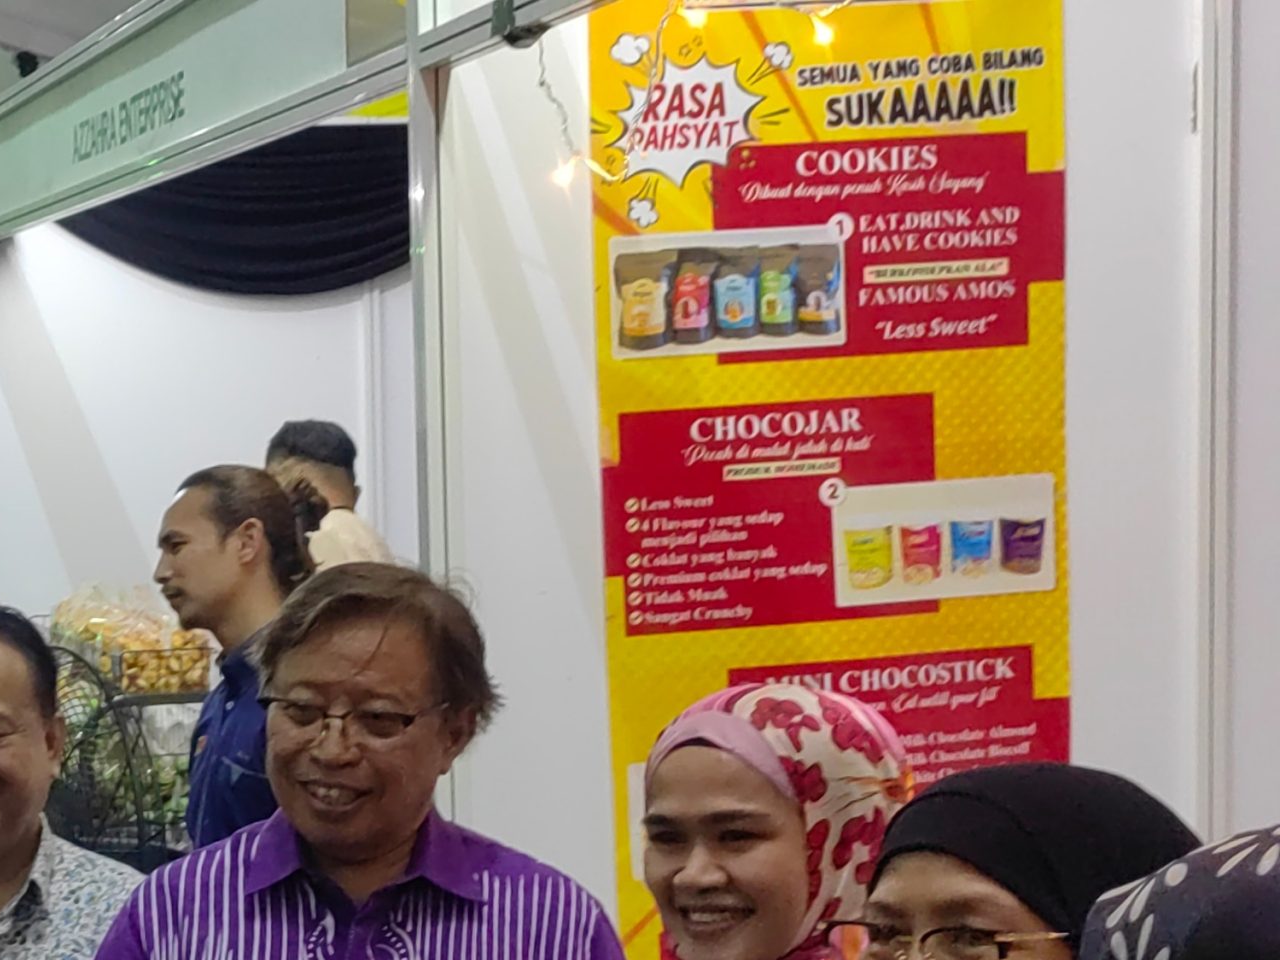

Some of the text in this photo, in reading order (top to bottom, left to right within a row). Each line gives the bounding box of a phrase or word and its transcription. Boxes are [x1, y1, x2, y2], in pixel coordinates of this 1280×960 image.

[797, 48, 1044, 87] SEMUA YANG COBA BILANG
[119, 70, 185, 145] ENTERPRISE
[642, 82, 726, 123] RASA
[826, 78, 1017, 128] SUKAAAAA!!
[795, 144, 939, 177] COOKIES
[976, 206, 1021, 226] AND
[862, 227, 1018, 254] HAVE COOKIES
[858, 279, 1017, 307] FAMOUS AMOS
[689, 407, 863, 443] CHOCOJAR
[827, 483, 839, 499] 2
[839, 656, 1016, 692] CHOCOSTICK
[927, 729, 985, 745] Chocolate
[928, 748, 987, 764] Chocolate
